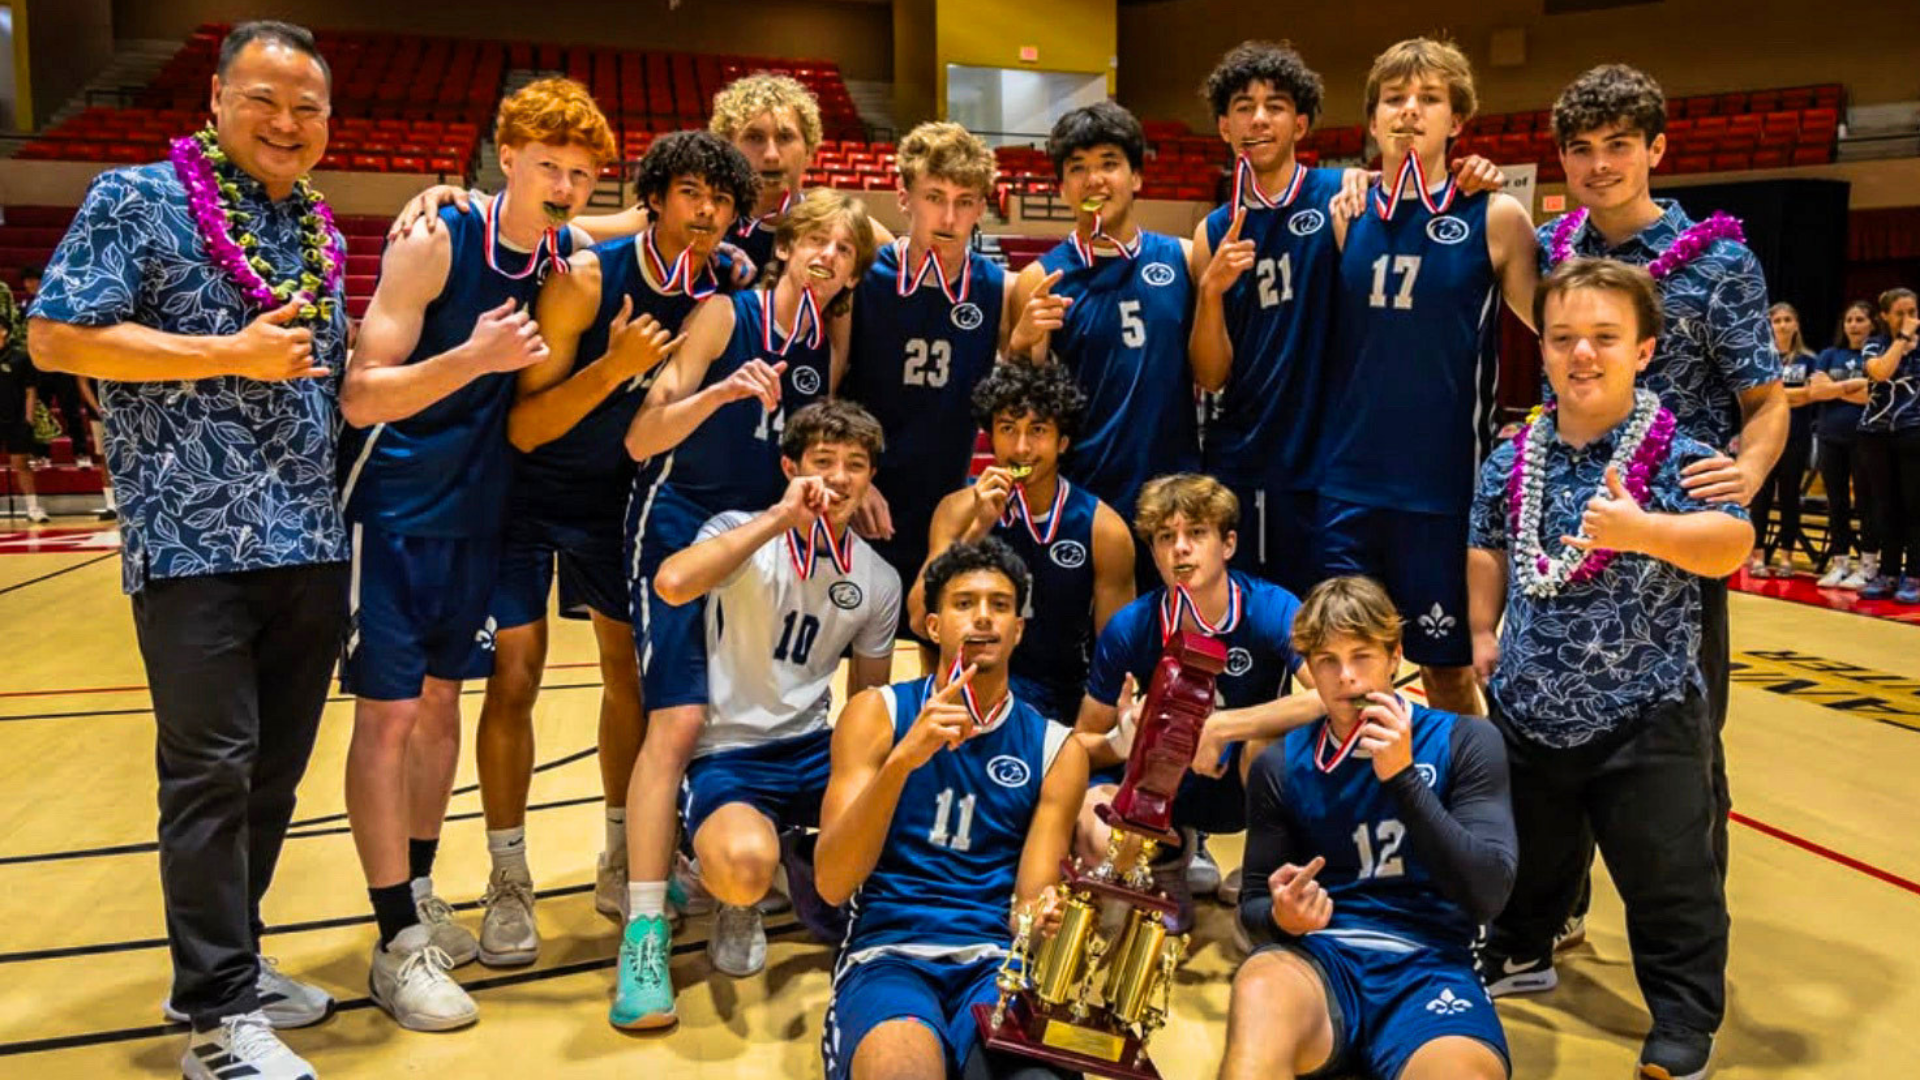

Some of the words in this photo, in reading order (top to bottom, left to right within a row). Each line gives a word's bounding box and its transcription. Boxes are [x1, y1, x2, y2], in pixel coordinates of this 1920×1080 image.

[1256, 252, 1293, 309] 21
[1369, 254, 1421, 309] 17
[1119, 300, 1145, 348] 5
[904, 338, 951, 388] 23
[773, 609, 820, 665] 10
[929, 788, 976, 851] 11
[1352, 819, 1405, 879] 12
